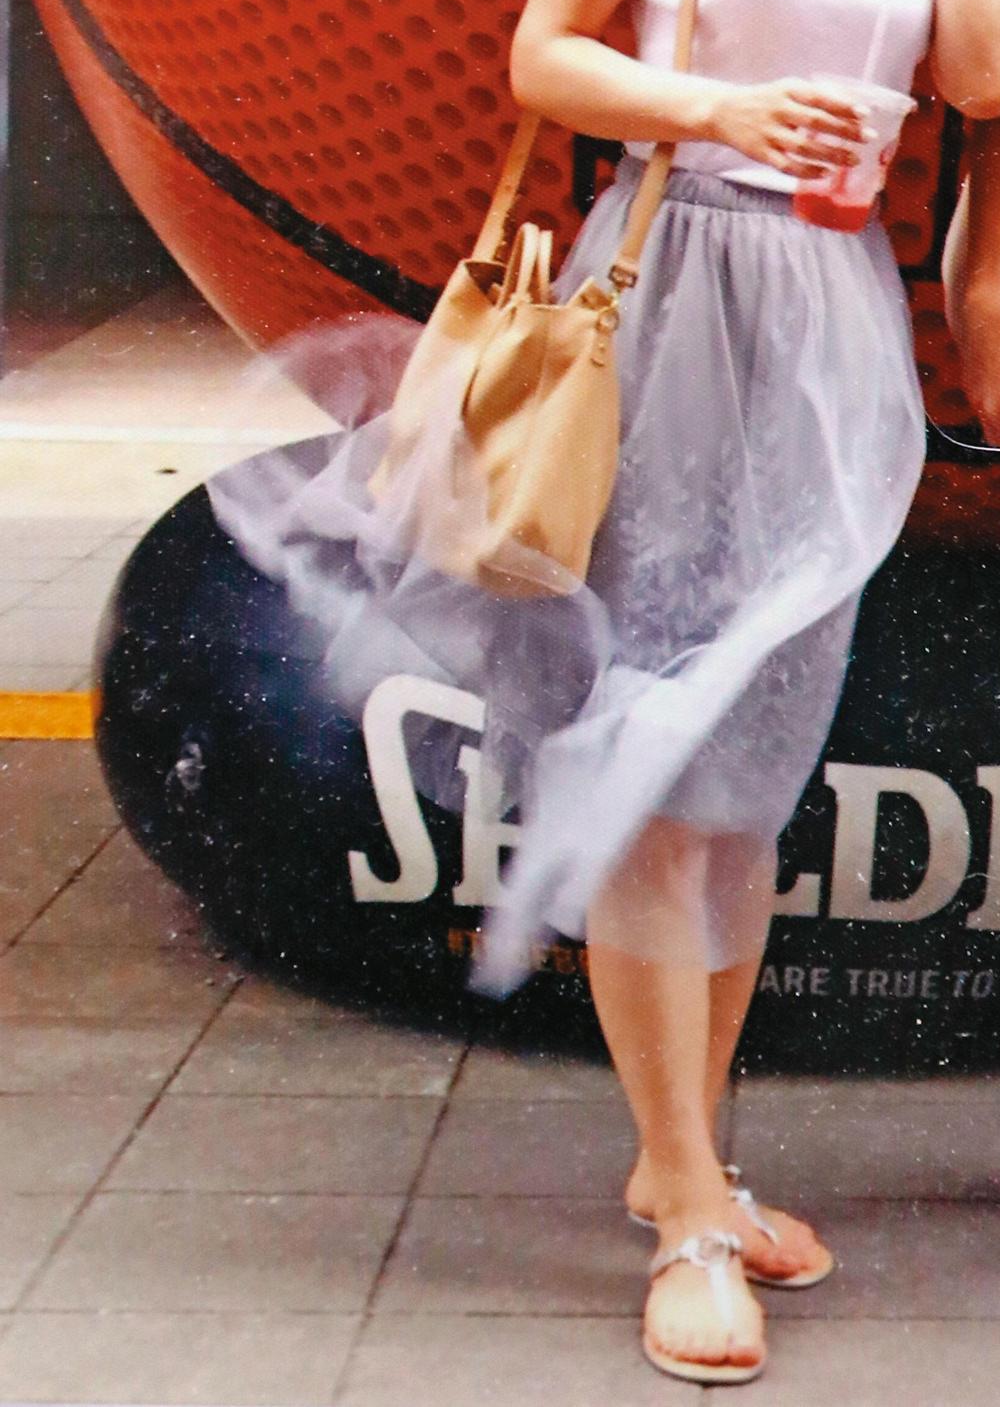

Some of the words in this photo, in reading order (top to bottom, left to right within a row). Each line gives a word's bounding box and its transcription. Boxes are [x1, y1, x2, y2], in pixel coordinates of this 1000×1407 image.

[759, 964, 832, 996] ARE
[845, 968, 941, 999] TRUE
[951, 969, 995, 998] TO
